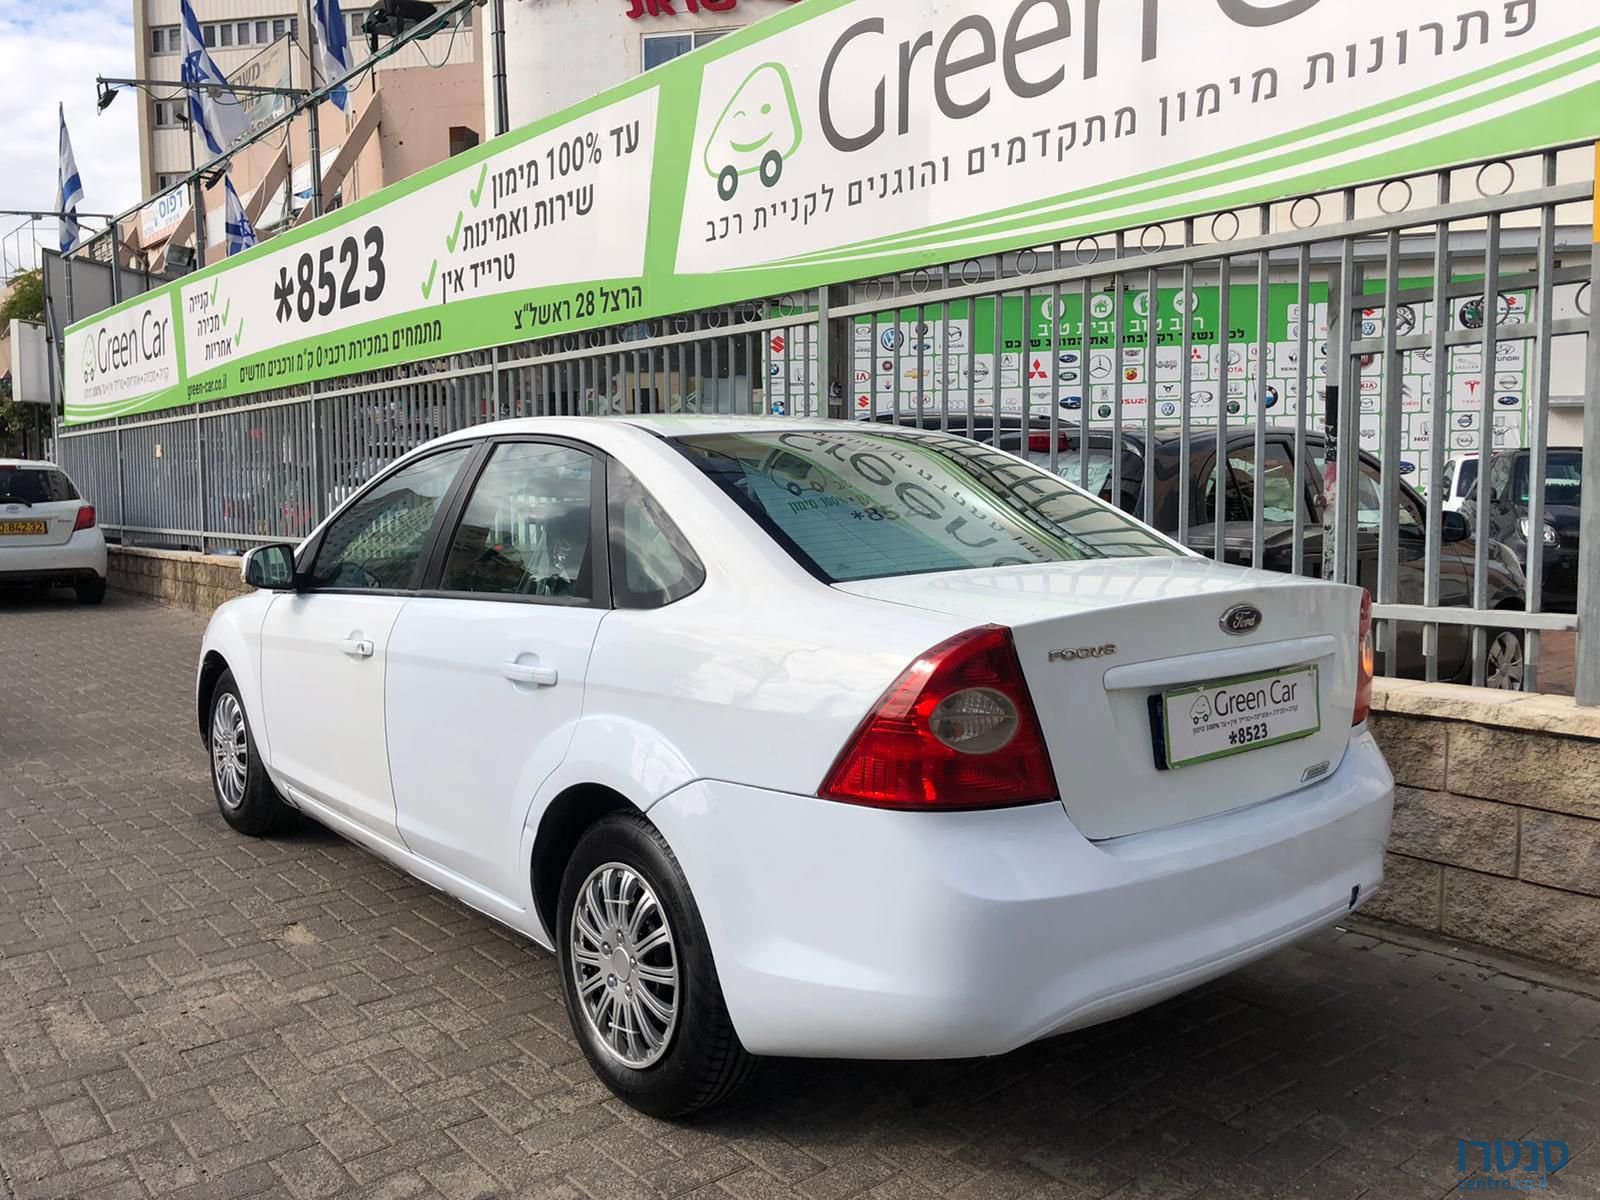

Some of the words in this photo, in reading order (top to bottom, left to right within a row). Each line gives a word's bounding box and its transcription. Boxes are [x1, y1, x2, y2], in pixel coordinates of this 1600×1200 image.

[1303, 0, 1537, 90] פתרונות
[819, 0, 1158, 152] Green
[1159, 67, 1278, 136] מימון
[609, 120, 640, 157] עד
[968, 106, 1137, 176] מתקדמים
[546, 132, 602, 180] 100%
[492, 159, 539, 209] מימון
[848, 156, 949, 206] והוגנים
[159, 190, 183, 218] דפוס
[534, 184, 594, 229] שירות
[752, 183, 834, 230] לקניית
[463, 206, 528, 251] ואמינות
[706, 213, 743, 242] רכב
[470, 252, 515, 288] טרייד
[441, 267, 464, 304] אין
[600, 285, 642, 313] הרצל
[189, 291, 209, 313] קנייה
[575, 290, 595, 318] 28
[197, 314, 220, 336] מכירה
[392, 319, 442, 350] מתמחים
[1038, 322, 1071, 336] טב
[1170, 317, 1204, 330] רב
[97, 327, 138, 374] Green
[141, 309, 168, 360] Car
[205, 338, 232, 361] אחריות
[325, 343, 346, 366] רכבי
[348, 332, 389, 360] במכירת
[1004, 338, 1041, 349] שכם
[240, 362, 266, 383] חדשים
[268, 354, 294, 378] ורכבים
[187, 372, 228, 401] green-car.co.il
[1232, 611, 1256, 629] Ford
[1048, 644, 1116, 663] FOCUS
[1214, 689, 1267, 717] Green
[1270, 680, 1297, 704] Car
